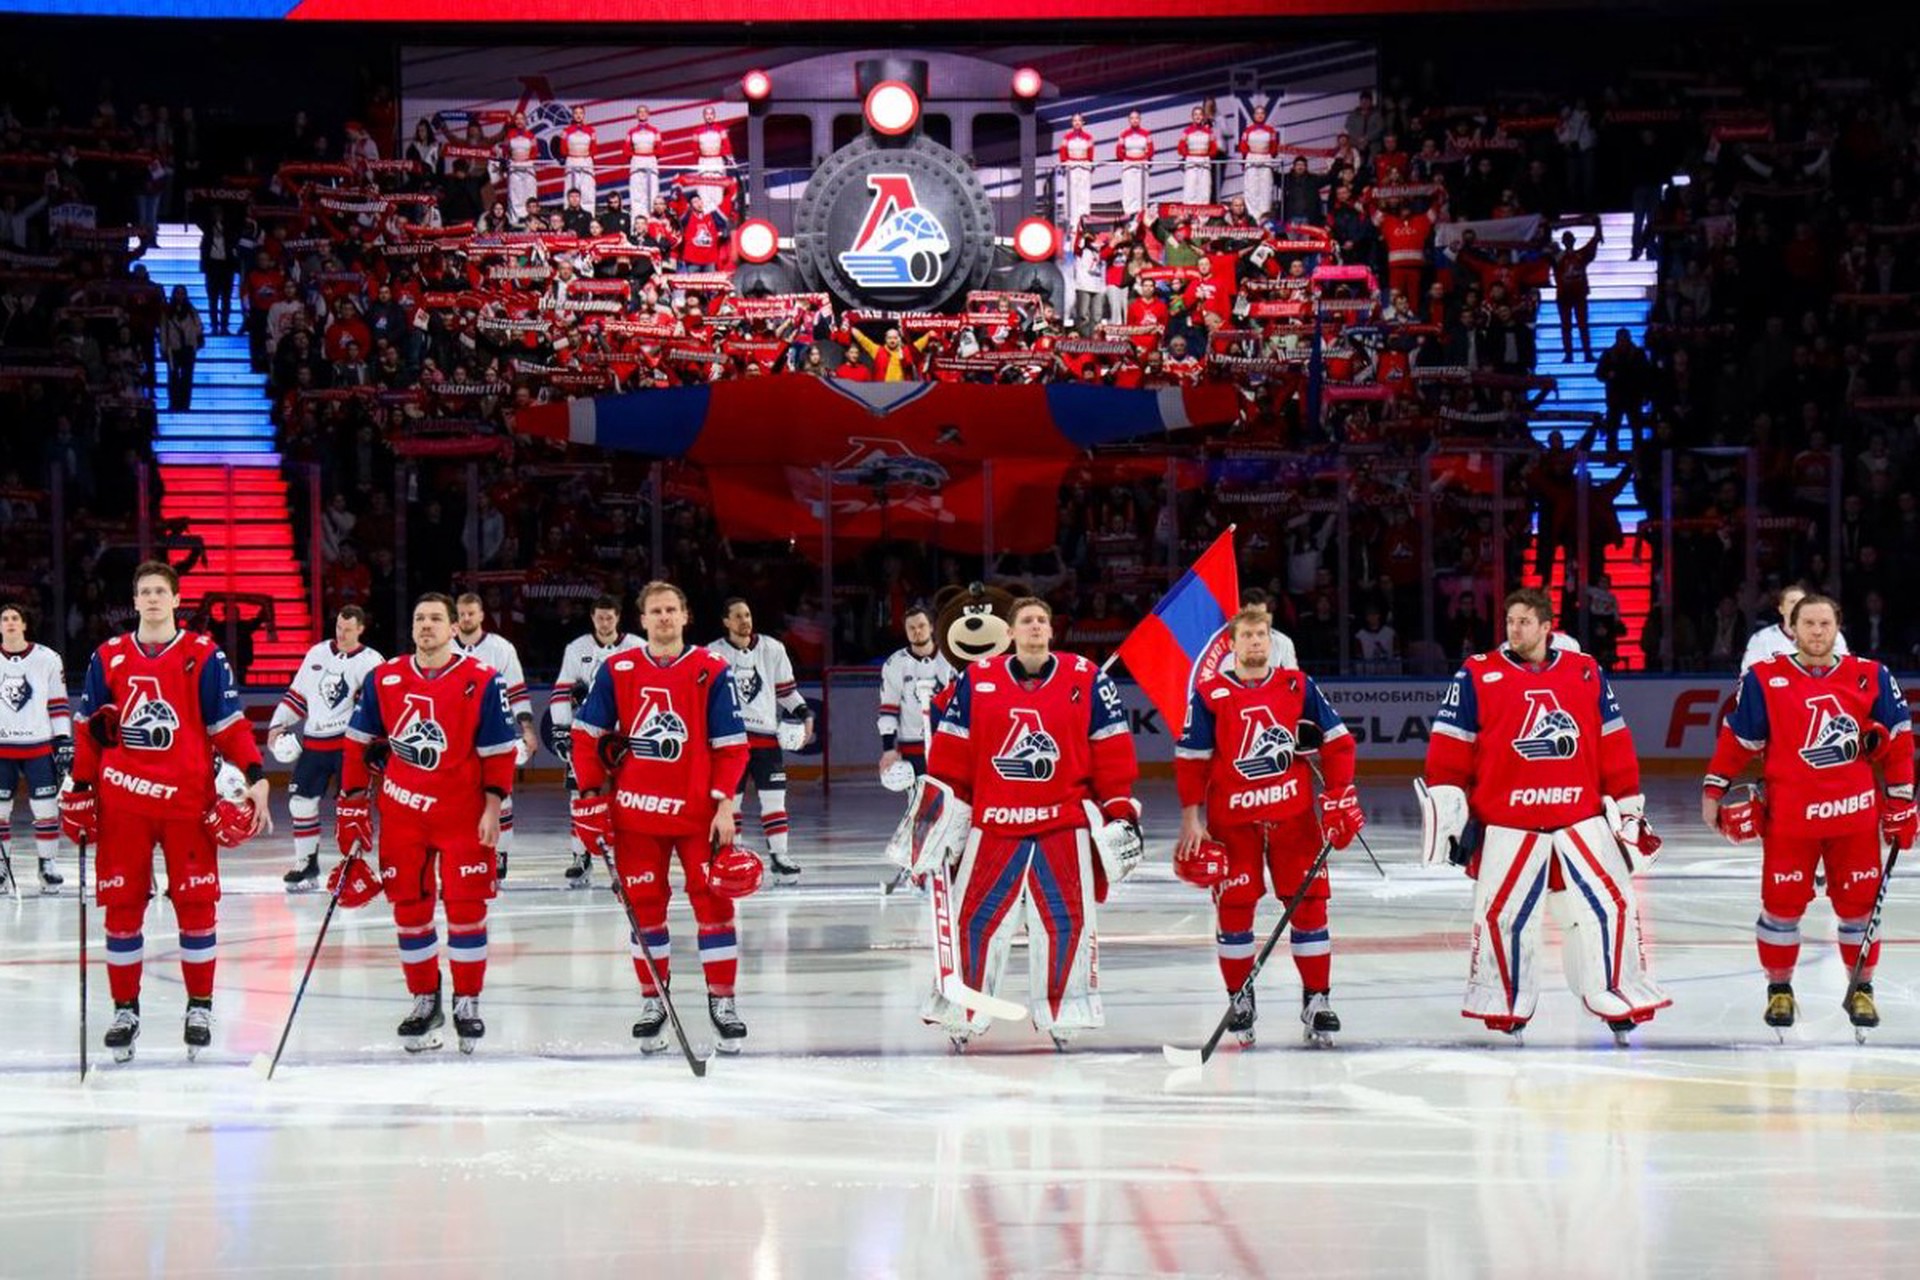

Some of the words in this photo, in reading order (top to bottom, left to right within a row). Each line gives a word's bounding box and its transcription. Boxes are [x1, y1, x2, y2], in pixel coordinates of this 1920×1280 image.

[102, 767, 178, 800] FONBET
[382, 778, 437, 813] ONBET
[1229, 779, 1298, 810] FONBET
[1509, 786, 1584, 807] FONBET
[982, 805, 1062, 824] FONBET
[1806, 789, 1876, 820] FONBET
